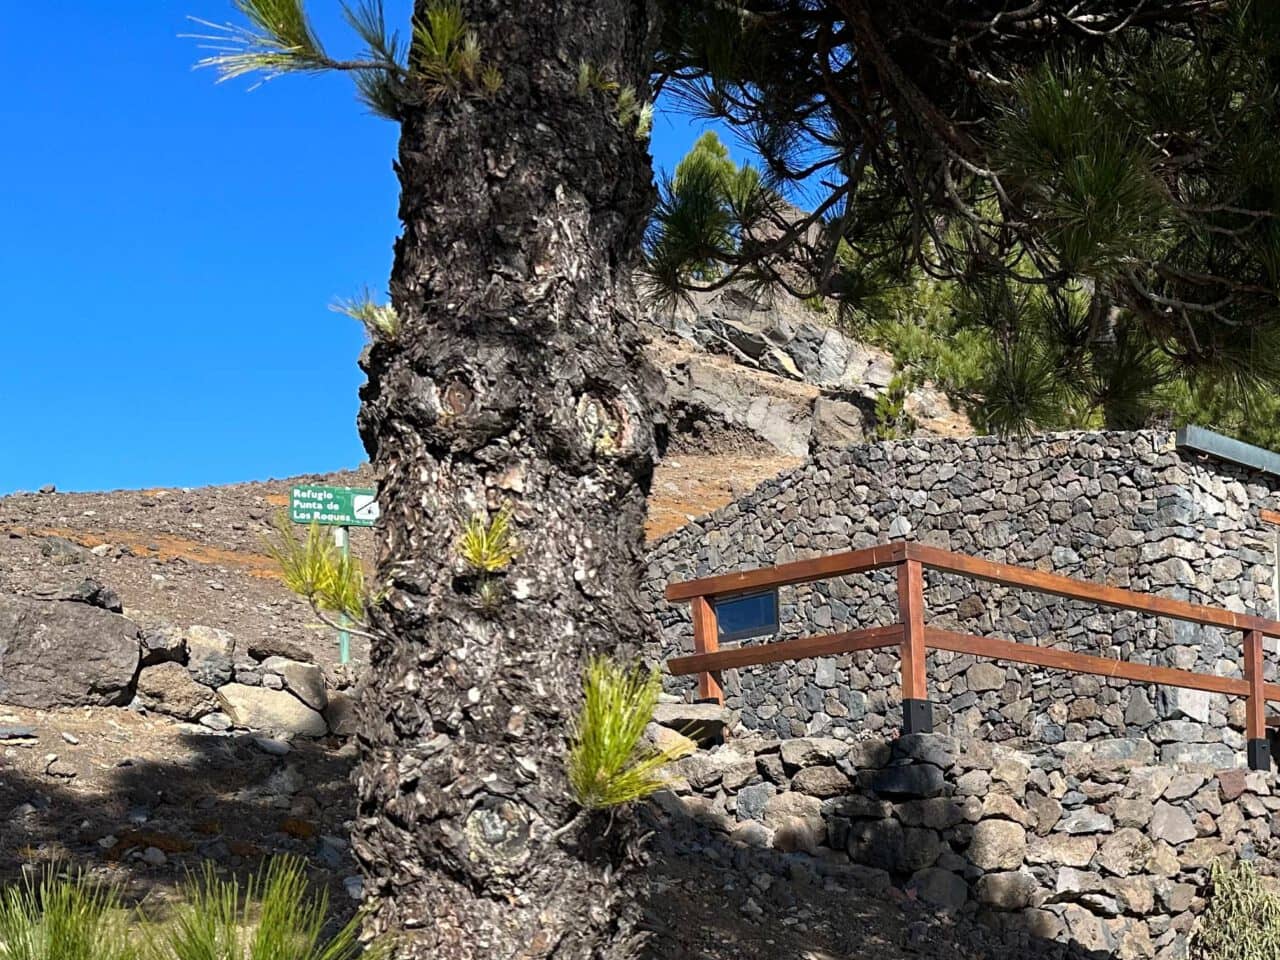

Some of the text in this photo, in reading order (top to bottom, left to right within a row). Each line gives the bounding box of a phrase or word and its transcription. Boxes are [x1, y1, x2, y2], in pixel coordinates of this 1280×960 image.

[294, 489, 333, 501] Refugio
[294, 500, 340, 510] Punta de
[294, 510, 351, 521] Los Roques
